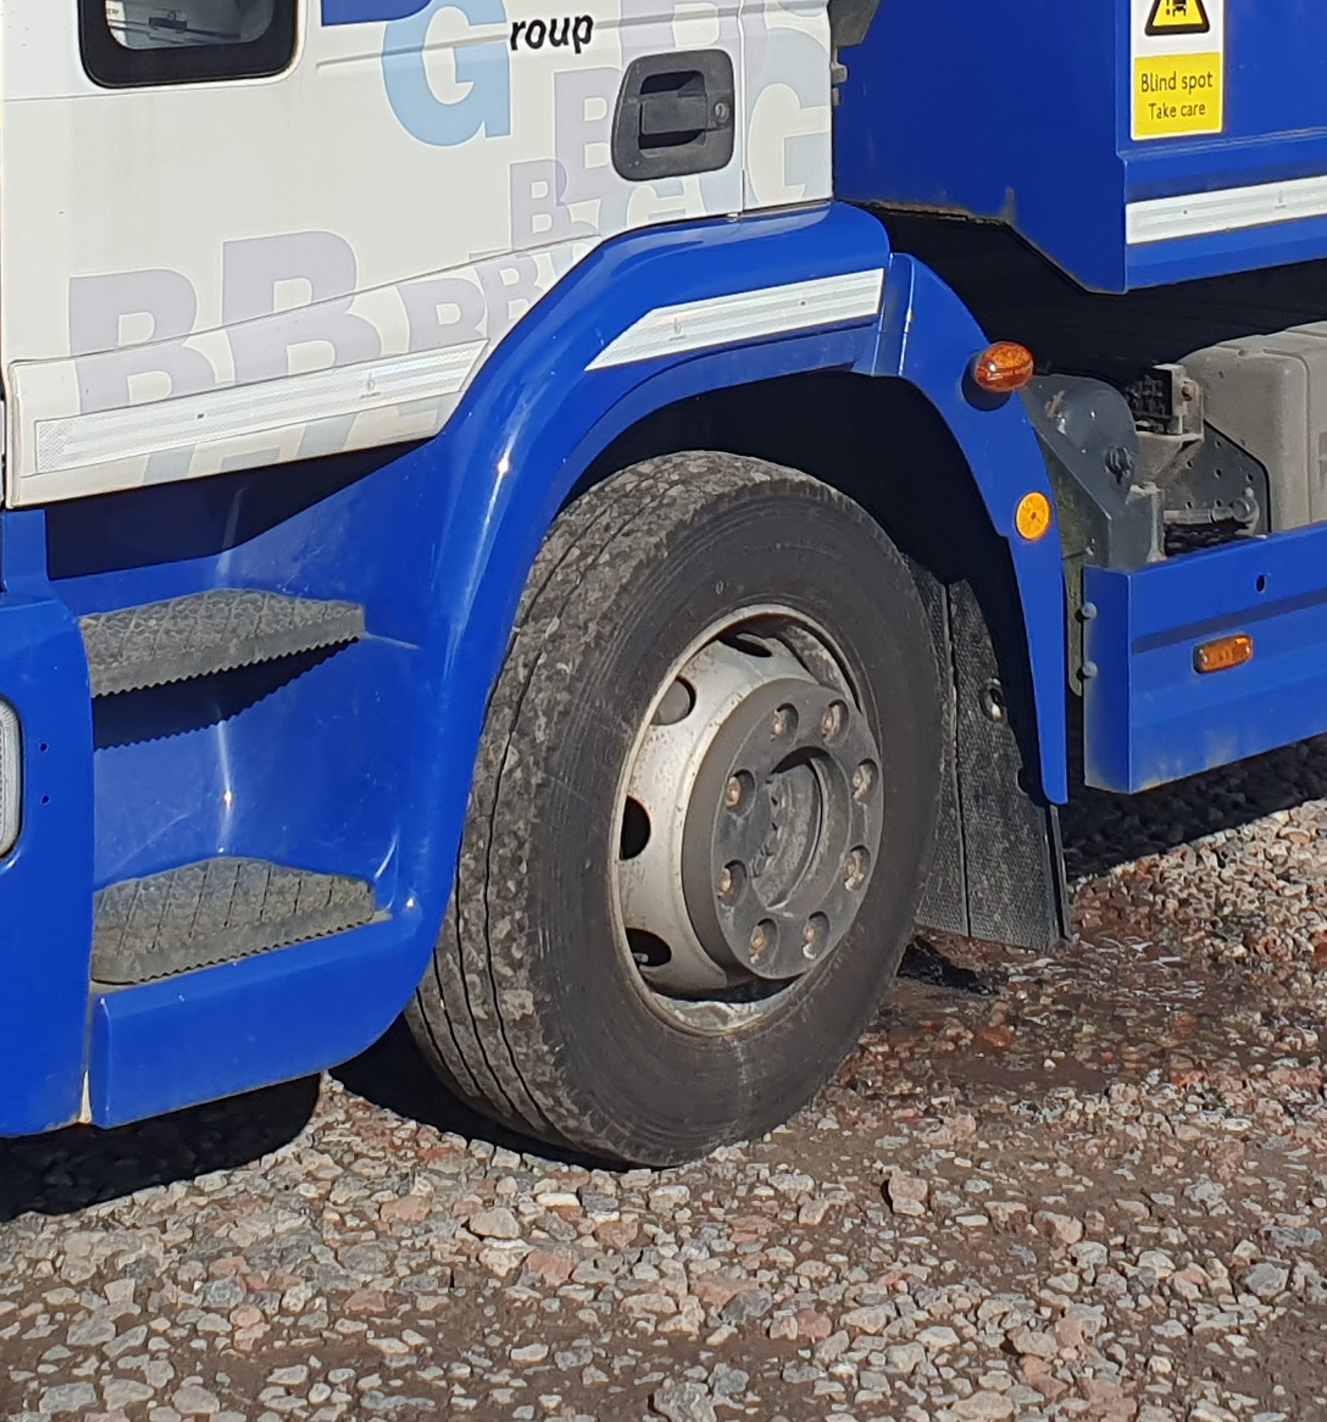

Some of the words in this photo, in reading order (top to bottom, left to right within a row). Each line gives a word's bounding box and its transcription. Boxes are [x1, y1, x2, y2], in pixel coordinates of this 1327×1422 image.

[1140, 71, 1177, 93] Blind
[1181, 72, 1214, 94] spot
[1148, 102, 1177, 121] Take
[1180, 102, 1206, 117] care
